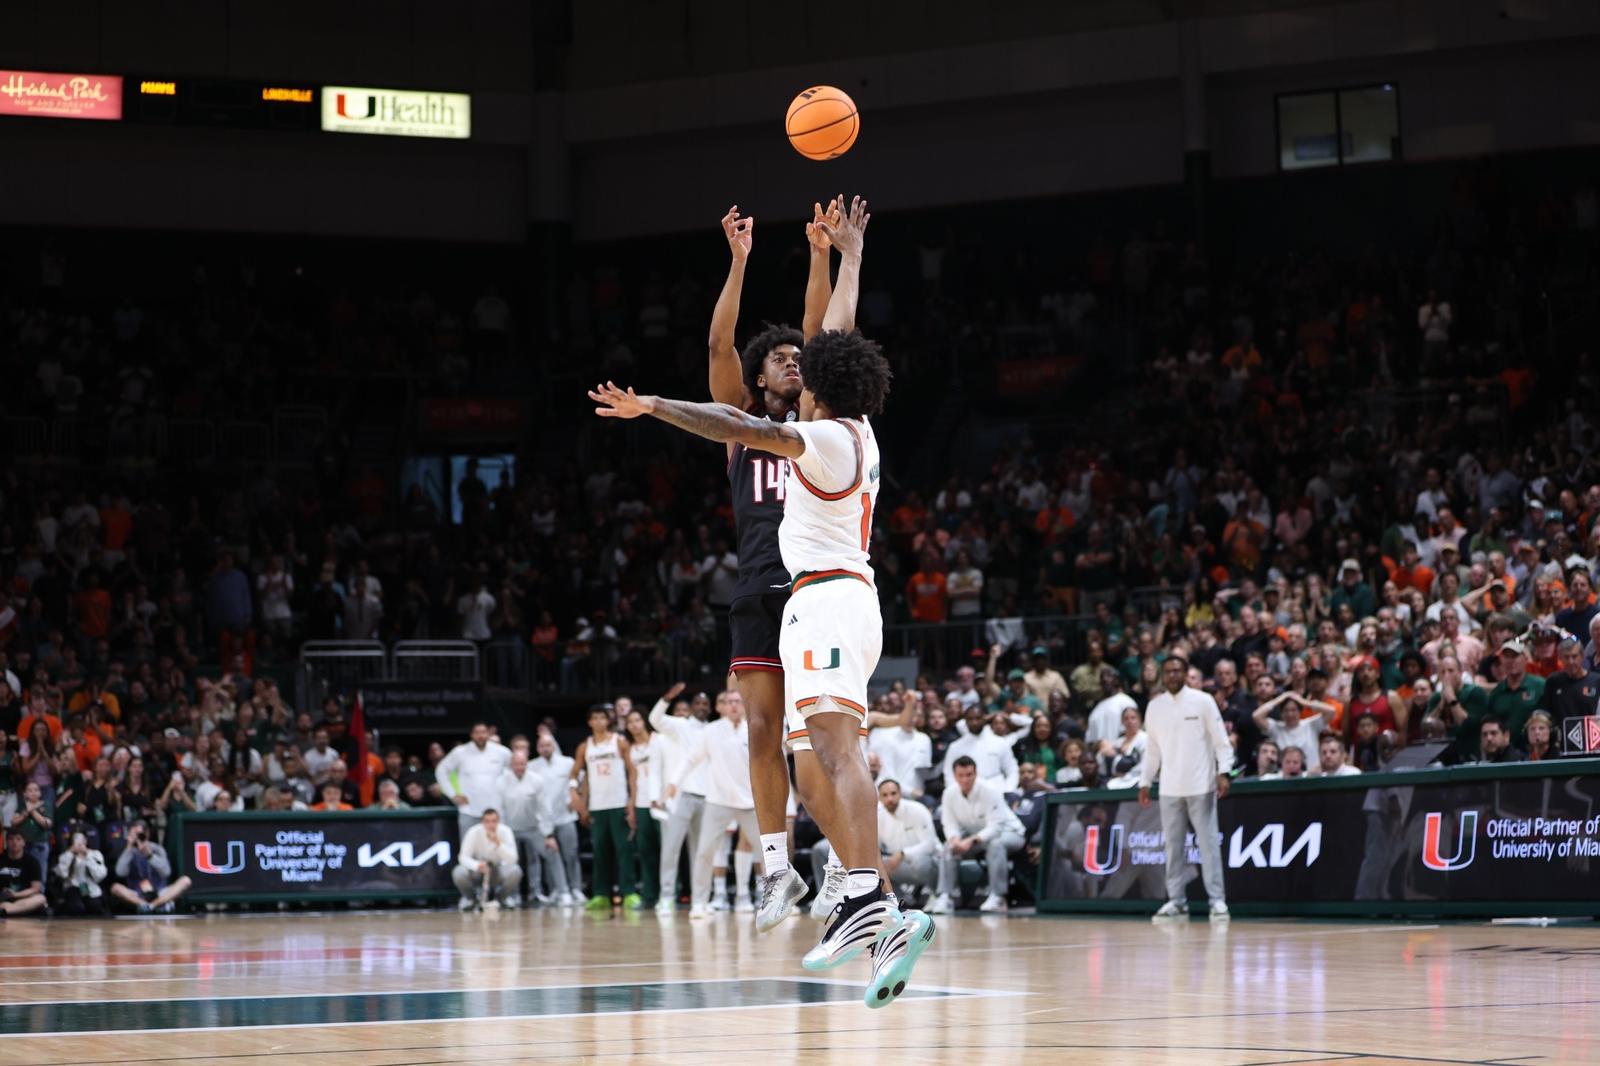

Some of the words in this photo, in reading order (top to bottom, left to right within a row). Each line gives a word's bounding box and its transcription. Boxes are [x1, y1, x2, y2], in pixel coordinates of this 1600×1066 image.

[751, 458, 785, 503] 14
[803, 648, 840, 671] U
[276, 830, 324, 845] Official
[1128, 831, 1160, 847] Official
[1486, 818, 1531, 839] Official
[1534, 816, 1583, 838] Partner
[1585, 815, 1600, 836] of
[255, 843, 305, 857] Partner
[306, 843, 323, 857] of
[324, 843, 348, 857] the
[1083, 824, 1124, 875] U
[1228, 822, 1322, 868] KIA
[1422, 810, 1478, 872] U
[1492, 838, 1556, 862] University
[1557, 837, 1573, 857] of
[1574, 837, 1600, 857] Mia
[194, 841, 246, 874] U
[259, 857, 326, 872] University
[327, 857, 344, 870] of
[357, 841, 451, 868] KIA
[281, 870, 323, 883] Miami
